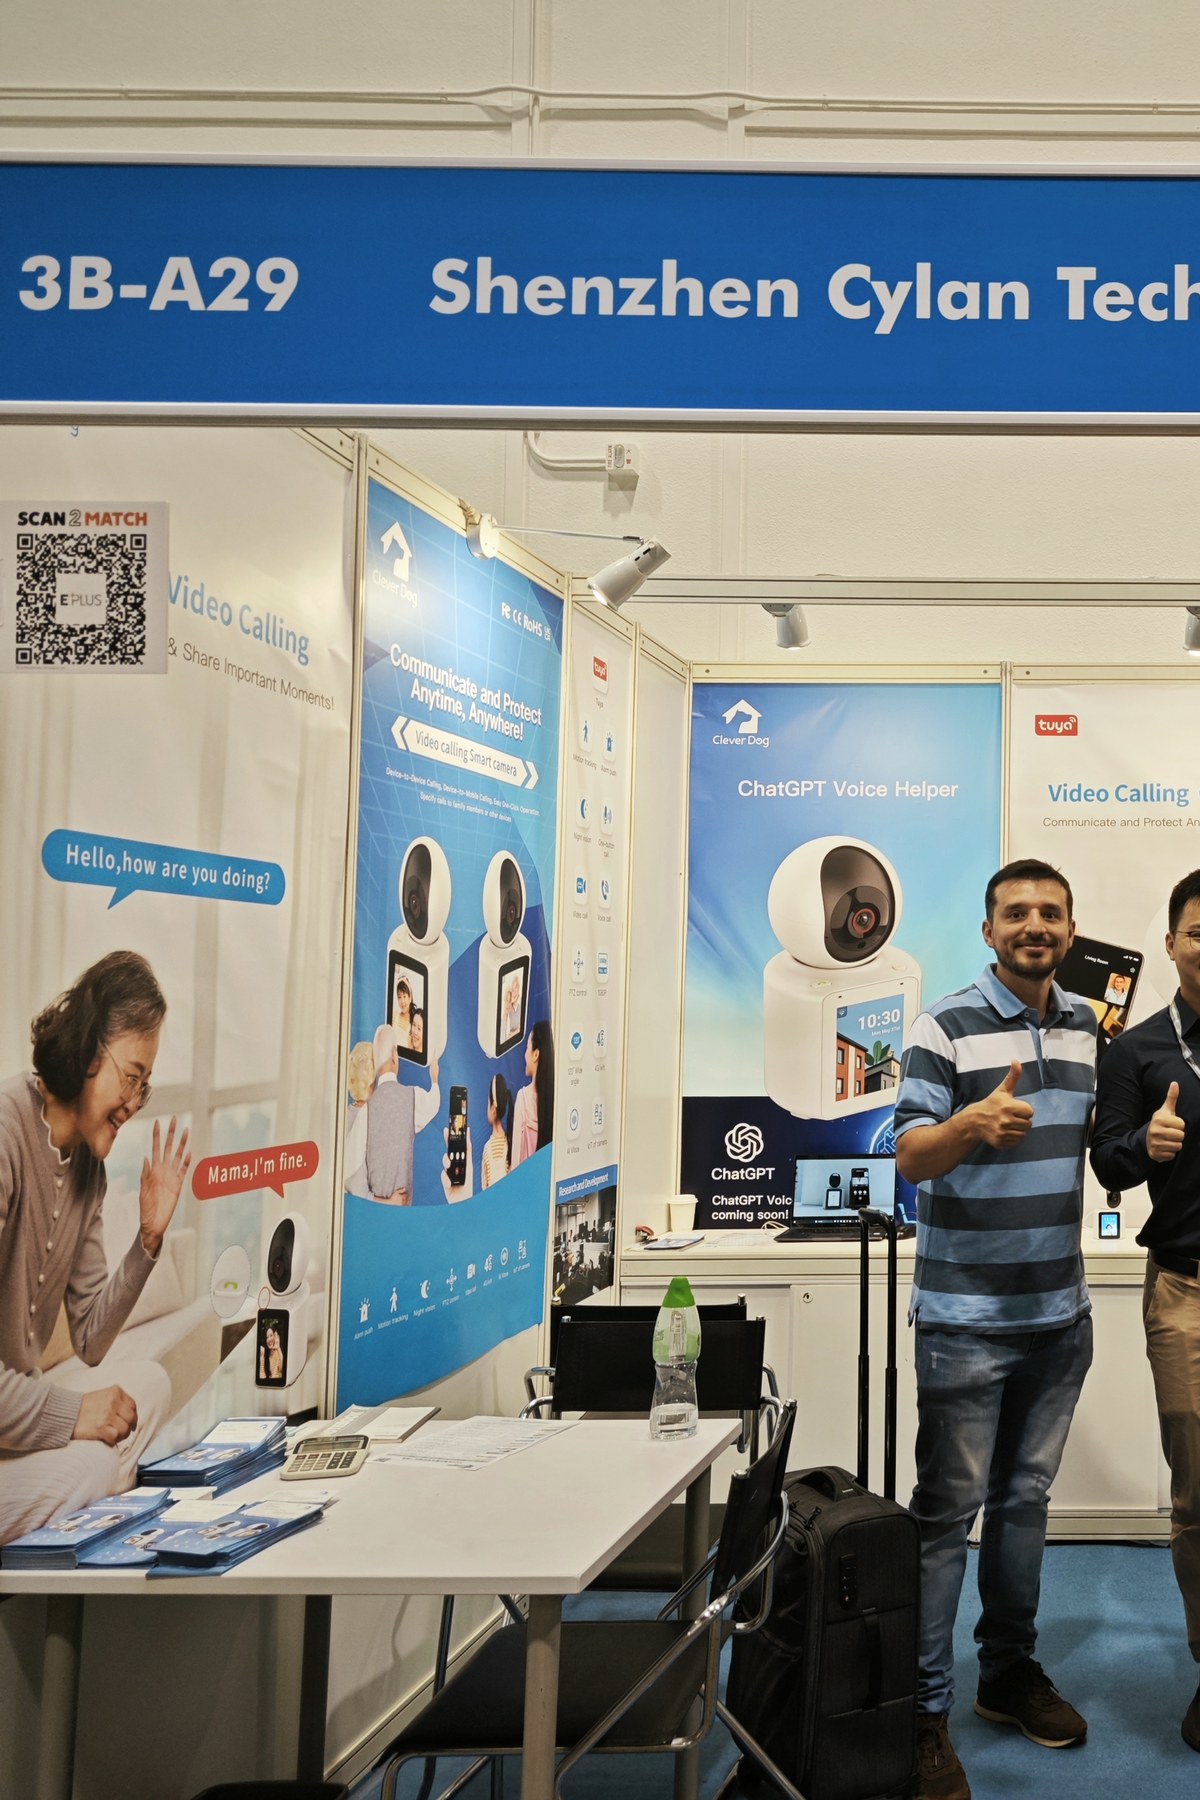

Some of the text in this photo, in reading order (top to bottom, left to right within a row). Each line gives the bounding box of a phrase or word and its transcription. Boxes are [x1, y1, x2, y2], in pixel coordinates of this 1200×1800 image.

[19, 255, 299, 311] 3B-A29
[430, 258, 799, 318] Shenzhen
[828, 263, 1030, 335] Cylan
[17, 509, 148, 527] SCAN 2 MATCH
[372, 569, 418, 608] Clever Dog
[168, 571, 310, 666] Video Calling
[523, 614, 543, 637] RoHS
[168, 637, 335, 711] & Share Important Moments!
[390, 643, 542, 726] Communicate and Protect
[410, 678, 524, 740] Anytime, Anywhere!
[1038, 718, 1073, 734] tuya
[712, 735, 770, 748] Clever Dog
[415, 730, 517, 777] Video calling Smart camera
[386, 767, 426, 785] Device-to-Device
[738, 780, 959, 801] ChatGPT Voice Helper
[1047, 783, 1109, 803] Video
[1114, 783, 1190, 807] Calling
[1042, 817, 1117, 827] Communicate
[1120, 817, 1140, 827] and
[1143, 817, 1183, 827] Protect
[66, 843, 271, 894] Hello,how are you doing?
[858, 1008, 900, 1030] 10:30
[208, 1152, 307, 1185] Mama,I'm fine.
[711, 1167, 776, 1180] ChatGPT
[559, 1181, 577, 1197] Research
[585, 1172, 609, 1188] Development
[712, 1195, 793, 1206] ChatGPT Voic
[711, 1209, 789, 1222] coming soon!
[391, 1313, 409, 1325] tracking
[413, 1308, 424, 1318] Night
